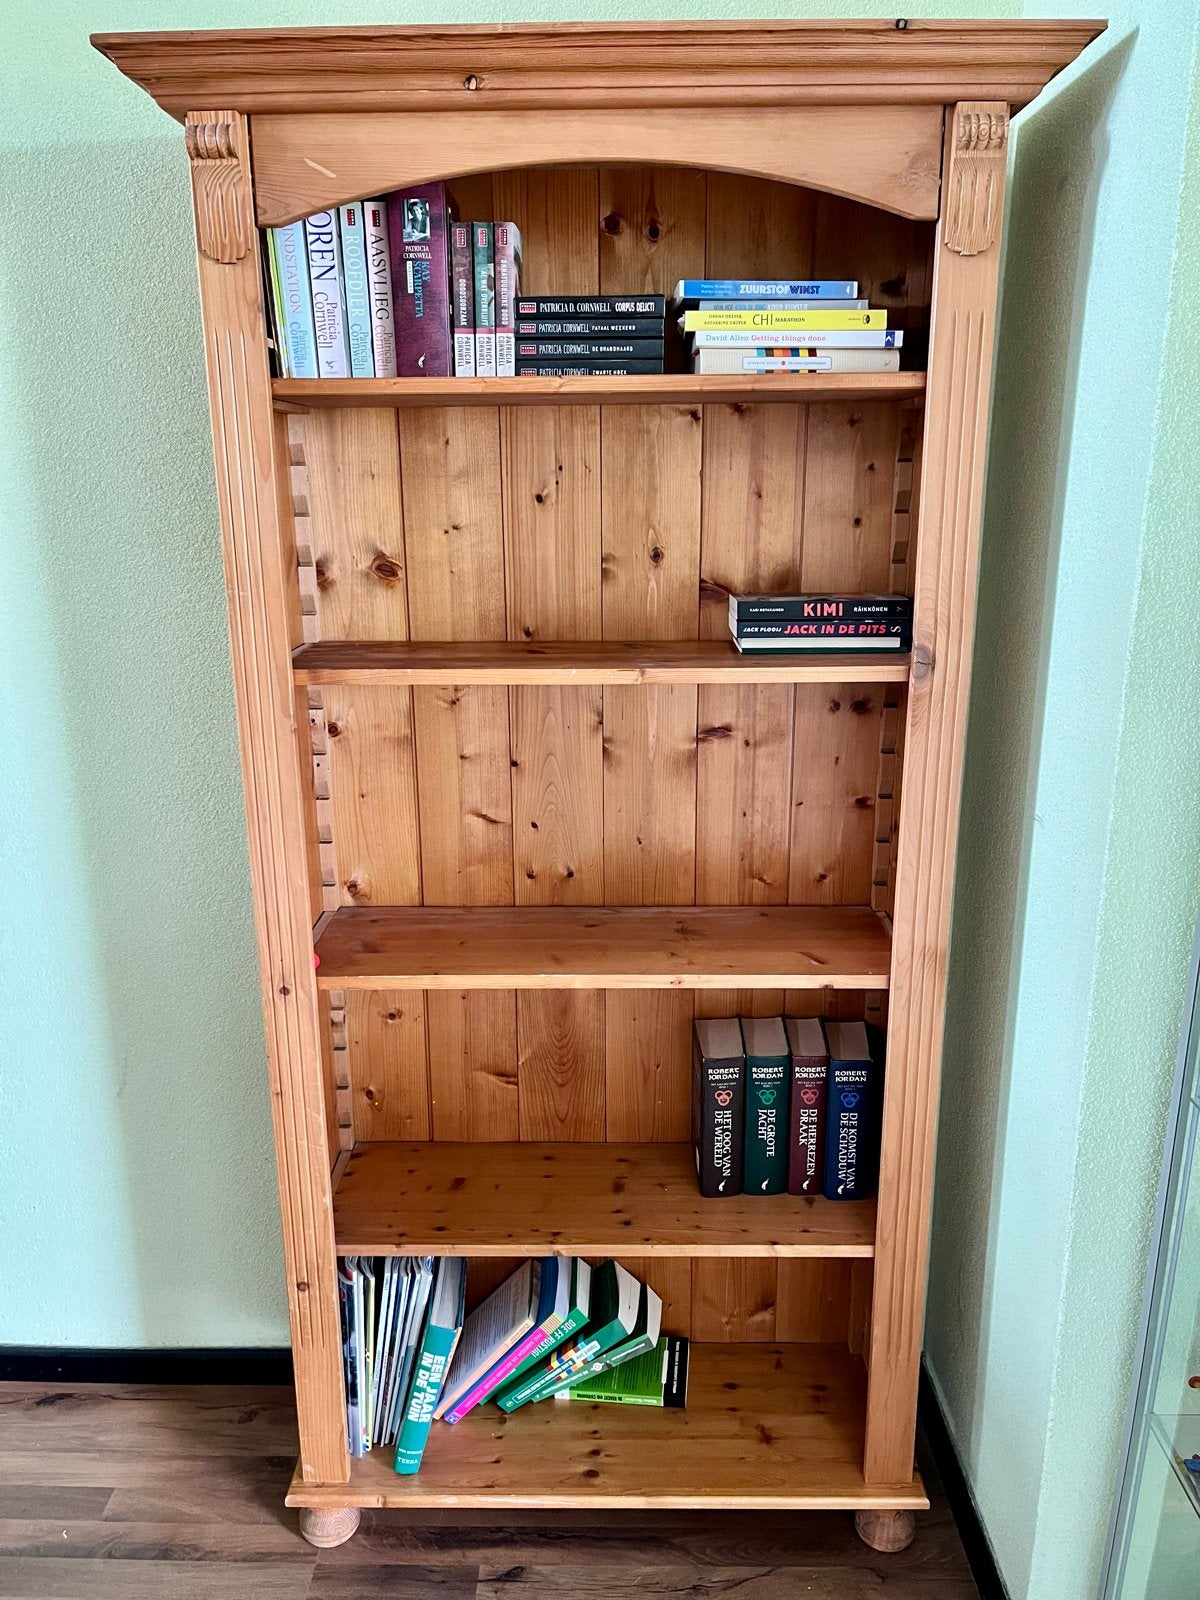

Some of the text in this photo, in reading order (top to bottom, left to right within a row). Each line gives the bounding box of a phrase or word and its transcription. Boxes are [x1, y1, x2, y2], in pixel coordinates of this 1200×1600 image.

[307, 211, 337, 281] OREN
[403, 252, 432, 260] CORNWELL
[283, 228, 301, 313] INDSTATION
[345, 235, 364, 317] ROOFDIER
[371, 233, 390, 320] AASVLIEG
[422, 261, 431, 282] KAY
[481, 270, 487, 278] AL
[500, 259, 509, 306] ONNATUURLIJKE
[413, 261, 424, 318] SCARPETTA
[459, 278, 467, 327] DOODSOORZAAK
[539, 302, 569, 313] PATRICIA
[569, 302, 576, 313] D.
[576, 302, 612, 313] CORNWELL
[615, 302, 635, 312] CORPUS
[636, 302, 655, 312] DELICTI
[314, 292, 333, 349] Cornwell
[326, 302, 340, 340] Patricia
[538, 323, 562, 333] PATRICIA
[563, 324, 590, 333] CORNWELL
[752, 313, 773, 326] CHI
[290, 321, 305, 369] Cornwell
[299, 330, 308, 361] Patricia
[351, 323, 366, 370] Cornwell
[359, 331, 370, 364] Patricia
[375, 325, 389, 371] Cornwell
[384, 332, 394, 365] Patricia
[538, 344, 562, 354] PATRICIA
[563, 344, 590, 354] CORNWELL
[751, 334, 780, 343] Getting
[781, 335, 806, 343] things
[539, 368, 562, 376] PATRICIA
[563, 368, 590, 376] CORNWELL
[803, 603, 843, 617] KIMI
[784, 624, 817, 635] JACK
[820, 624, 834, 634] IN
[838, 624, 855, 634] DE
[858, 624, 887, 634] PITS
[708, 1067, 740, 1075] ROBERT
[752, 1066, 784, 1074] ROBERT
[714, 1110, 723, 1167] DE WERELD
[757, 1109, 767, 1140] JACHT
[766, 1109, 776, 1157] DE GROTE
[799, 1109, 809, 1146] DRAAK
[807, 1109, 818, 1176] DE HERREZEN
[722, 1110, 732, 1177] HET OOG VAN
[838, 1112, 849, 1180] DE SCHADUW
[846, 1112, 858, 1189] DE KOMST VAN
[554, 1330, 565, 1340] FF
[564, 1318, 577, 1333] DOE
[407, 1351, 434, 1423] IN DE TUIN
[418, 1354, 446, 1423] EEN JAAR
[397, 1456, 419, 1465] TERRA
